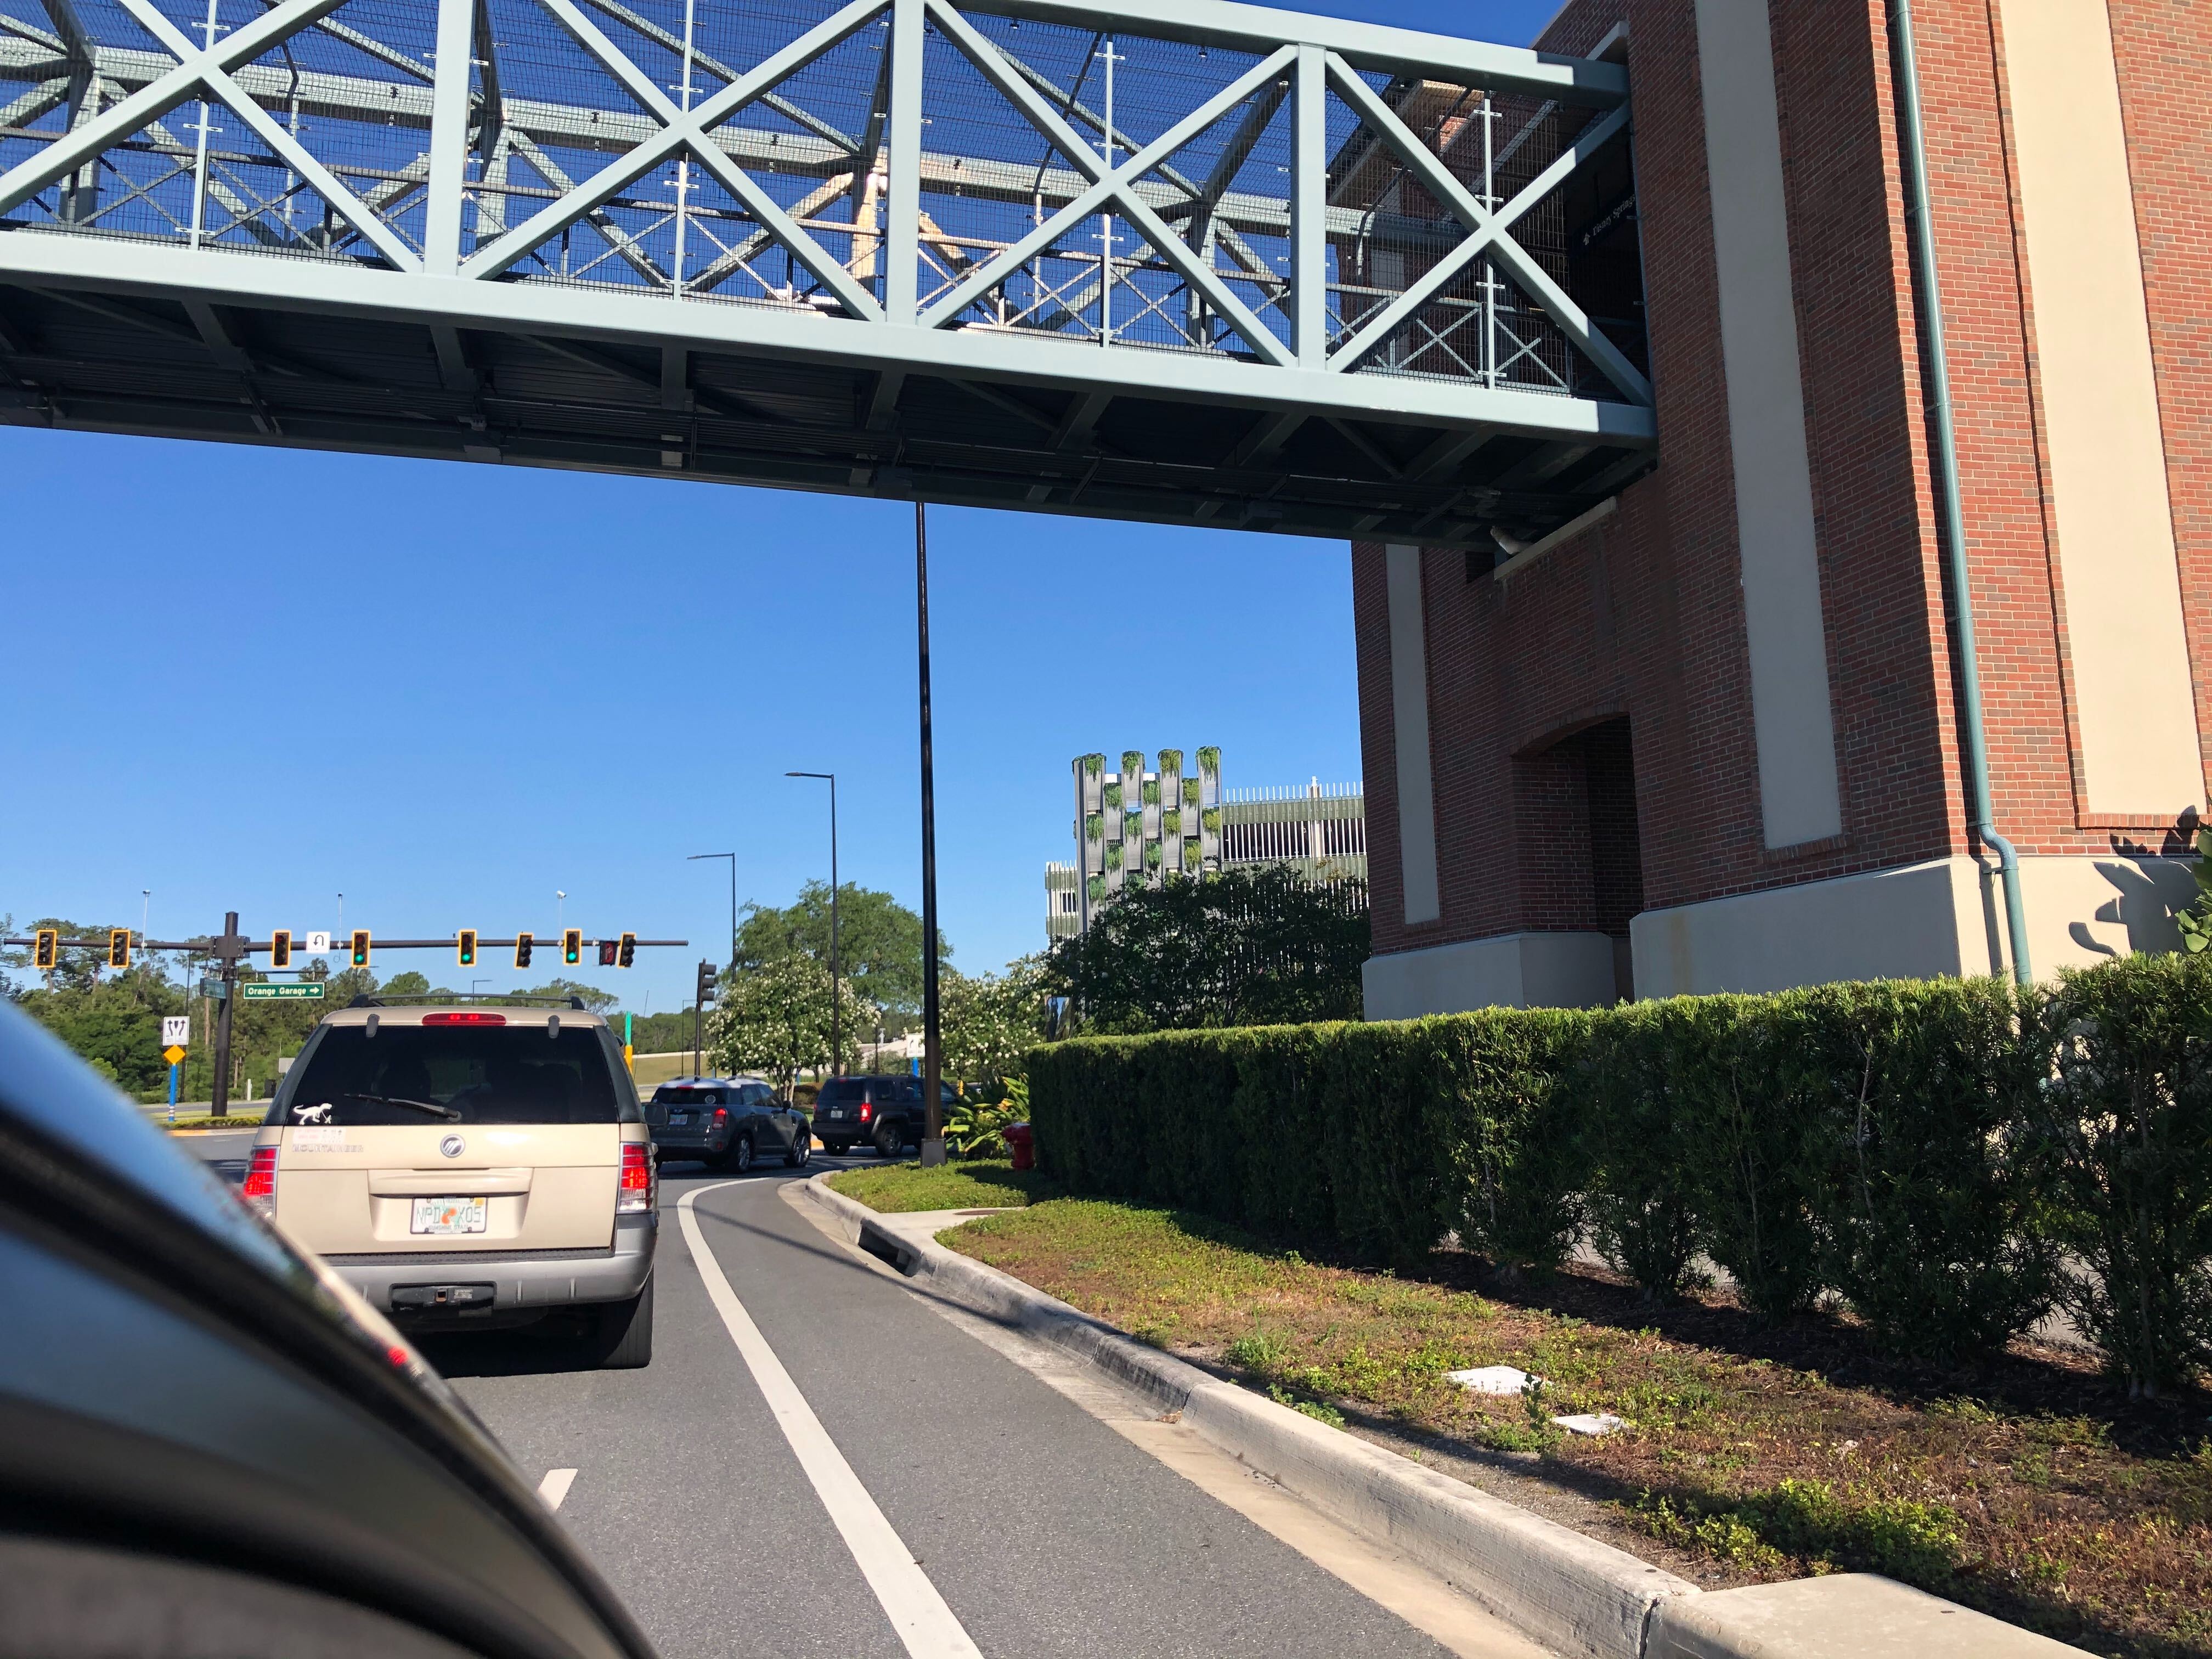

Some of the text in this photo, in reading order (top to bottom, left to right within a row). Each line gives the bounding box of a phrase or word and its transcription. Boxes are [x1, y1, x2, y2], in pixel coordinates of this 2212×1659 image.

[1593, 194, 1635, 236] Disney Springs
[248, 987, 307, 996] Orange Garage
[292, 1144, 364, 1153] MOUNTAINEER
